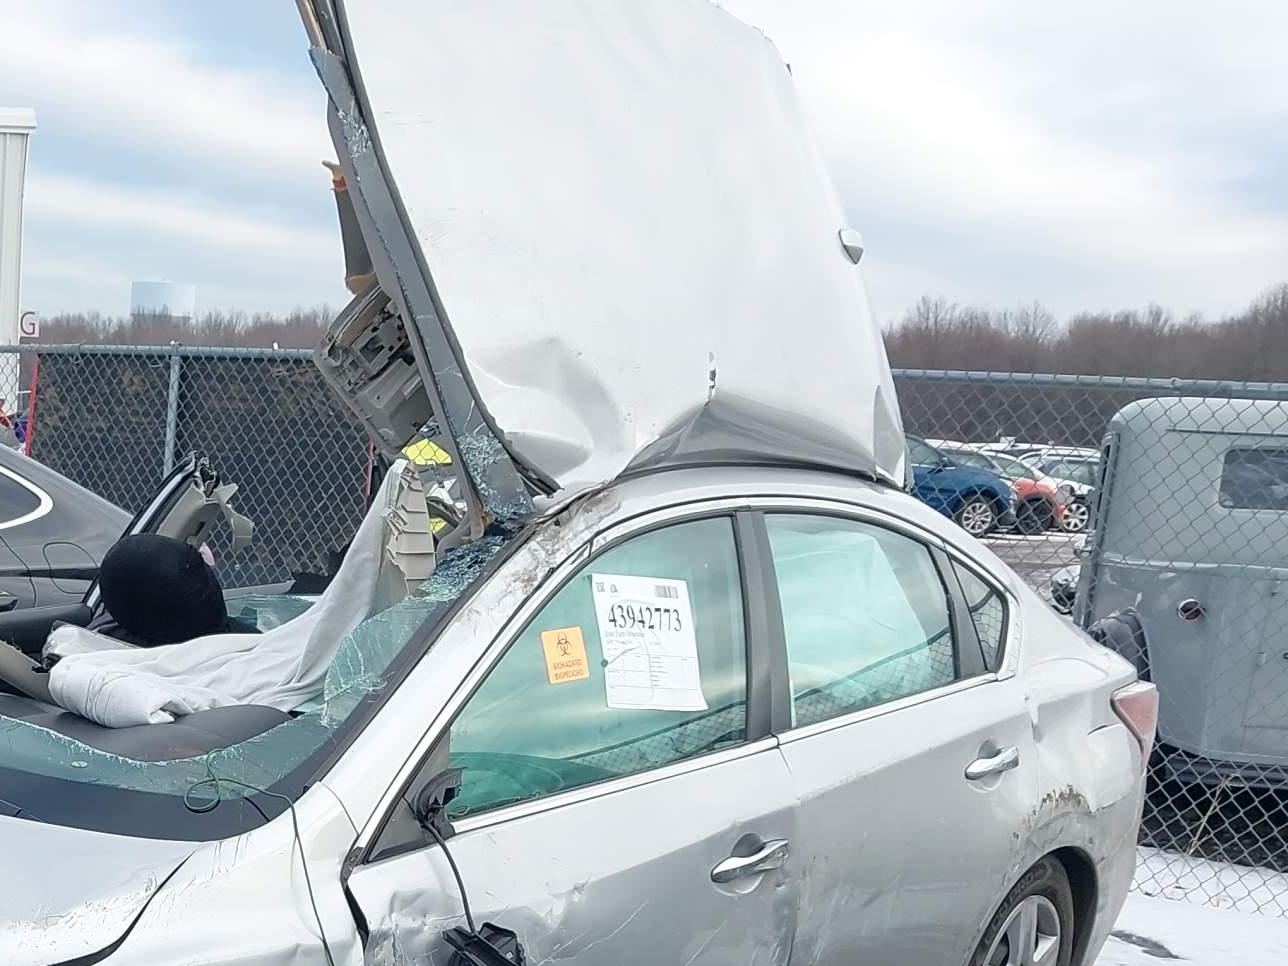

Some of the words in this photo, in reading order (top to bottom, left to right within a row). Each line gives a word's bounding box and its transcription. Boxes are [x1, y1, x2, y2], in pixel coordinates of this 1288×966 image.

[20, 311, 36, 336] G
[608, 604, 682, 632] 43942773
[553, 658, 582, 670] BIOHAZARD
